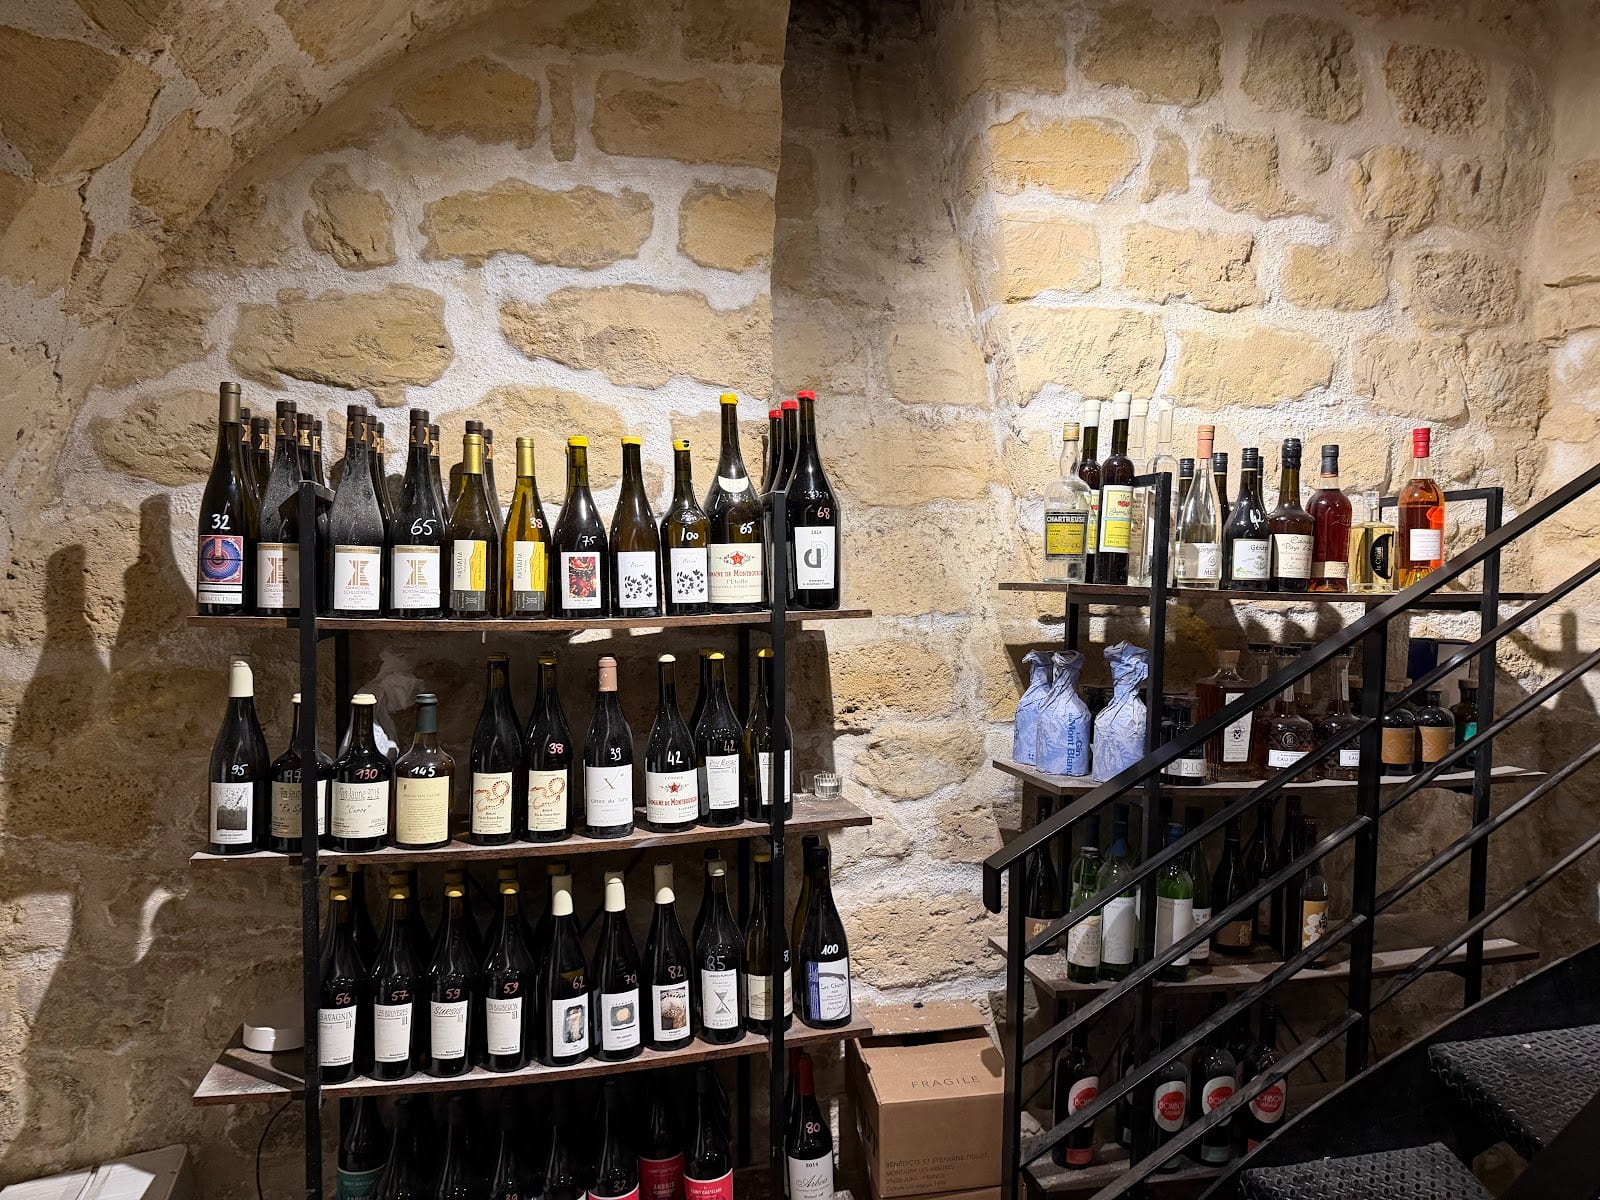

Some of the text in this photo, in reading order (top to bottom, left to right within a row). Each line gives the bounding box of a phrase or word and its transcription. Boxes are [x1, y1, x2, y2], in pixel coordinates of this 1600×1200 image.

[816, 506, 830, 520] 68
[211, 514, 231, 530] 32
[410, 518, 436, 536] 65
[530, 518, 544, 528] 38
[740, 522, 754, 534] 65
[582, 536, 598, 546] 75
[680, 528, 698, 542] 100
[1067, 721, 1075, 747] Mont
[549, 742, 564, 754] 38
[724, 740, 736, 753] 42
[610, 747, 621, 762] 39
[668, 750, 684, 766] 42
[231, 764, 248, 776] 95
[356, 768, 378, 780] 130
[410, 766, 436, 777] 145
[820, 944, 838, 956] 100
[668, 965, 683, 980] 82
[624, 973, 637, 985] 70
[446, 988, 460, 1000] 59
[504, 982, 519, 994] 59
[336, 992, 351, 1005] 56
[391, 990, 409, 1001] 57
[320, 1011, 352, 1022] SAVAGNIN
[912, 1075, 982, 1089] FRAGILE
[806, 1121, 820, 1134] 80
[613, 1180, 626, 1193] 32
